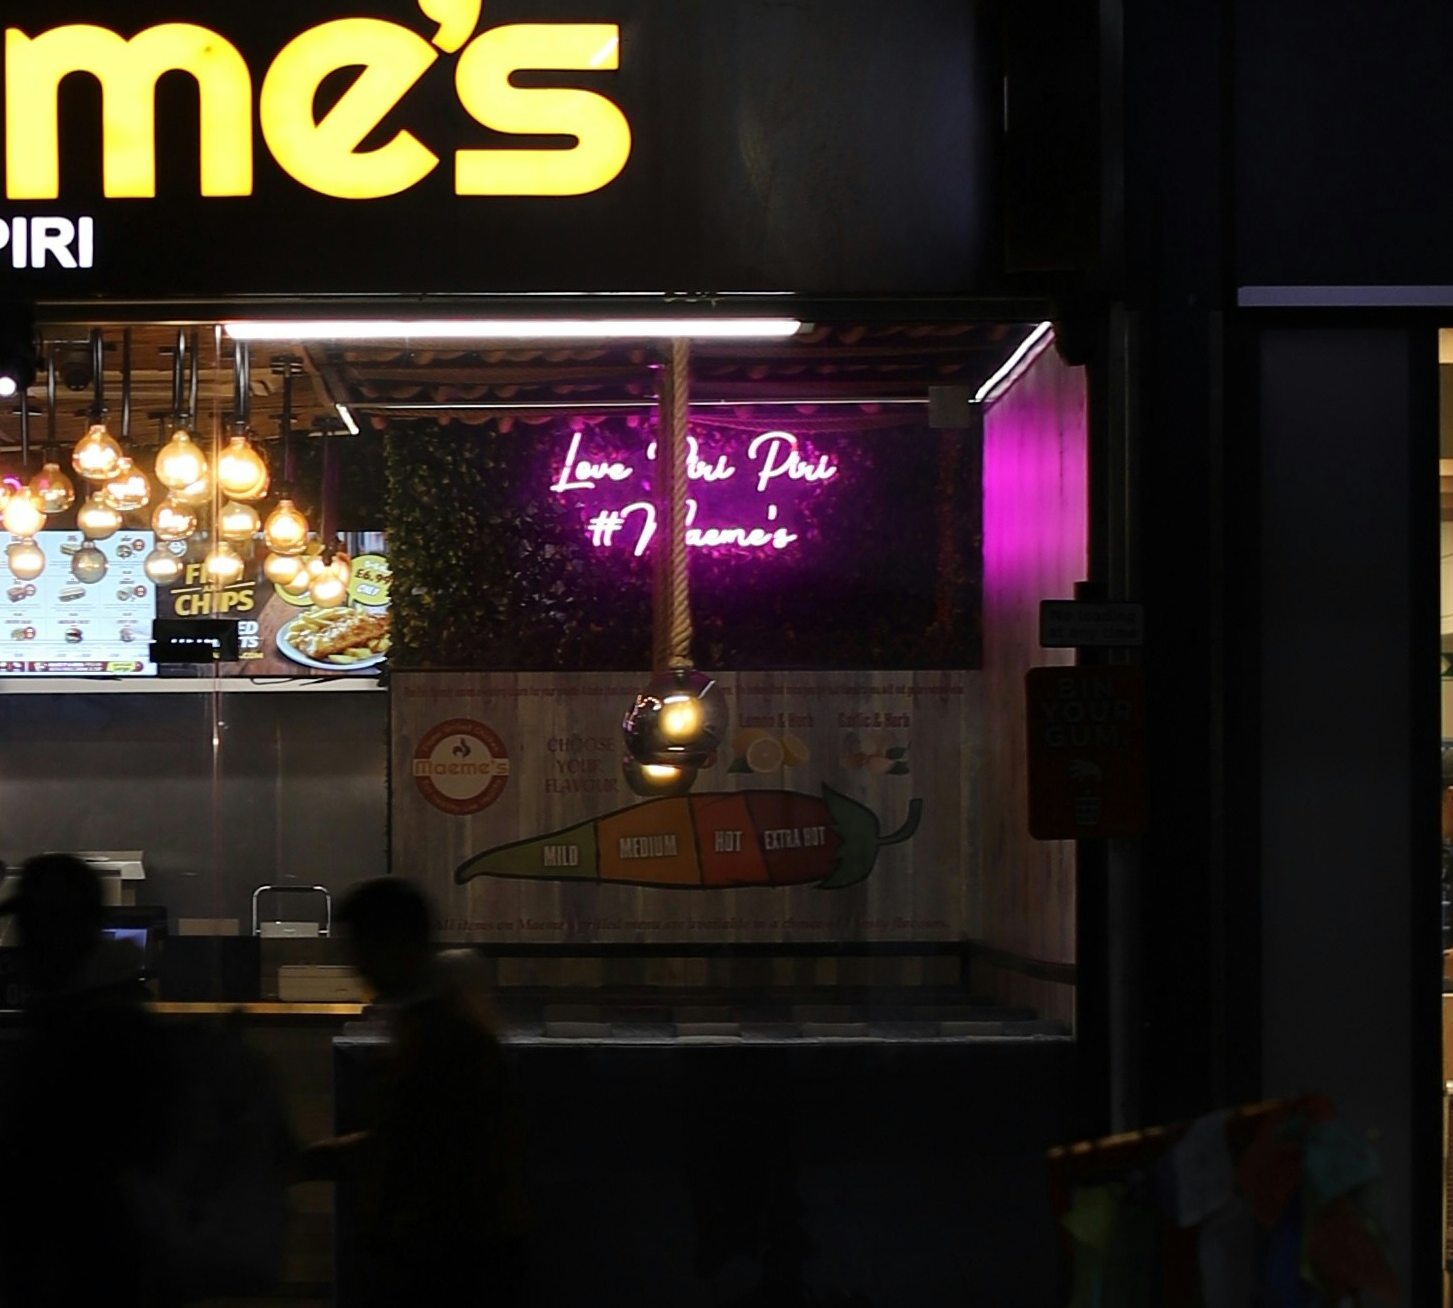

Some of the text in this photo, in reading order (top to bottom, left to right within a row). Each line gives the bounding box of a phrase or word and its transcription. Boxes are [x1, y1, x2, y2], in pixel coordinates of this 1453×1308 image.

[550, 432, 633, 493] Love
[748, 431, 837, 492] Piri
[174, 589, 255, 617] CHIPS
[1058, 677, 1113, 700] BIN
[1042, 700, 1133, 724] YOUR
[547, 737, 615, 752] CHOOSE
[414, 760, 508, 775] Maeme's
[556, 758, 600, 773] YOUR
[545, 778, 619, 793] FLAVOUR
[618, 834, 678, 859] MEDIUM
[714, 830, 744, 853] HOT
[764, 825, 827, 851] EXTRA HOT
[543, 845, 579, 867] MILD
